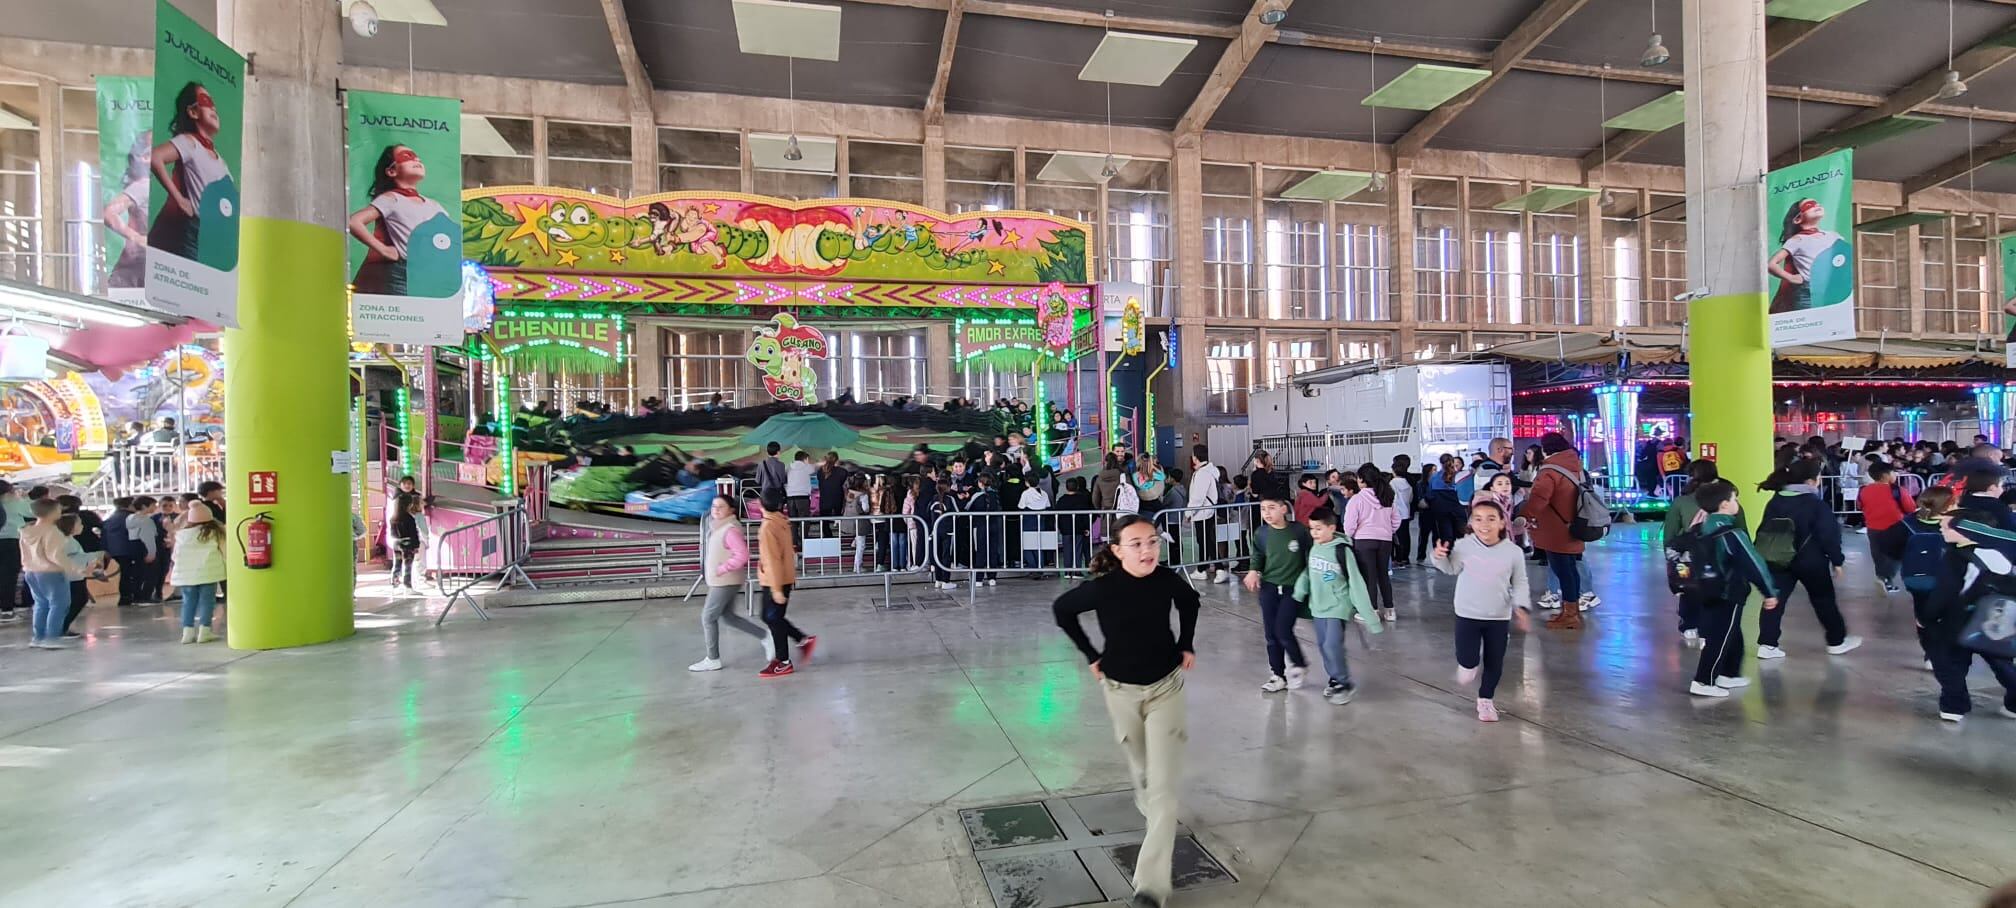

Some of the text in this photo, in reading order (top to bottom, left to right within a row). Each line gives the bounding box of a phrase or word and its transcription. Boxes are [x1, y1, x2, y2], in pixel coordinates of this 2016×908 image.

[164, 30, 237, 88] JUVELANDIA
[110, 99, 153, 111] JUVEL
[360, 114, 449, 132] JUVELANDIA
[1773, 169, 1844, 195] JUVELANDIA
[154, 261, 191, 279] ZONA DE
[153, 273, 209, 296] ATRACCIONES
[359, 304, 385, 312] ZONA
[359, 313, 425, 323] ATRACCIONES
[494, 320, 609, 342] CHENILLE
[967, 327, 1043, 344] AMOR EXPRE
[782, 337, 822, 351] GUSANO
